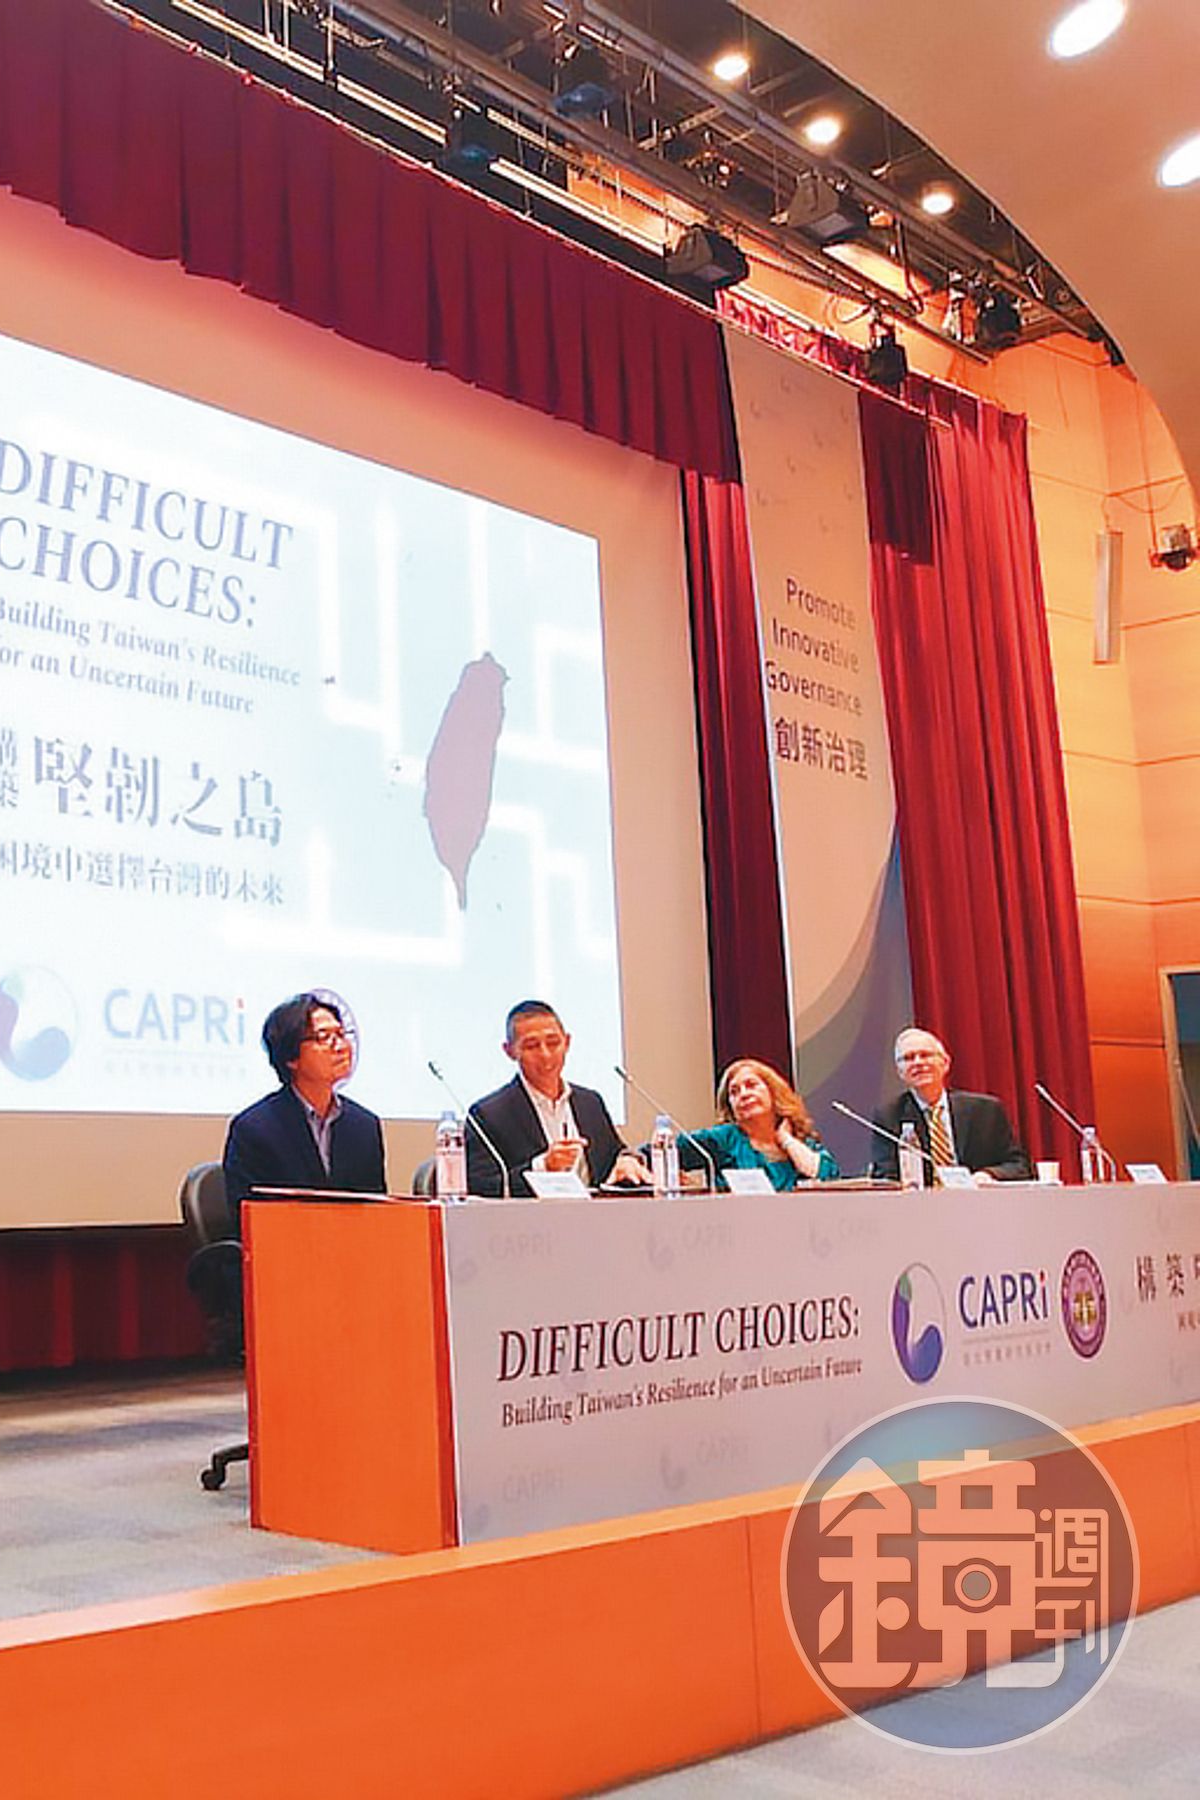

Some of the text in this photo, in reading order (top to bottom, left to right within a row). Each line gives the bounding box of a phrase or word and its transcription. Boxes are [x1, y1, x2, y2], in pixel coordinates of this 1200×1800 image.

[786, 578, 856, 632] Promote
[100, 619, 195, 663] Taiwan's
[202, 645, 300, 686] Resilience
[773, 617, 860, 674] Innovative
[30, 652, 60, 675] an
[69, 654, 179, 701] Uncertain
[187, 680, 254, 714] Future
[766, 661, 863, 718] Governance
[774, 716, 868, 781] 創新治理
[33, 735, 282, 847] 堅韌之島
[498, 1295, 860, 1382] DIFFICULT CHOICES:
[502, 1358, 862, 1428] Building Taiwan's Resilience for an Uncertain Future
